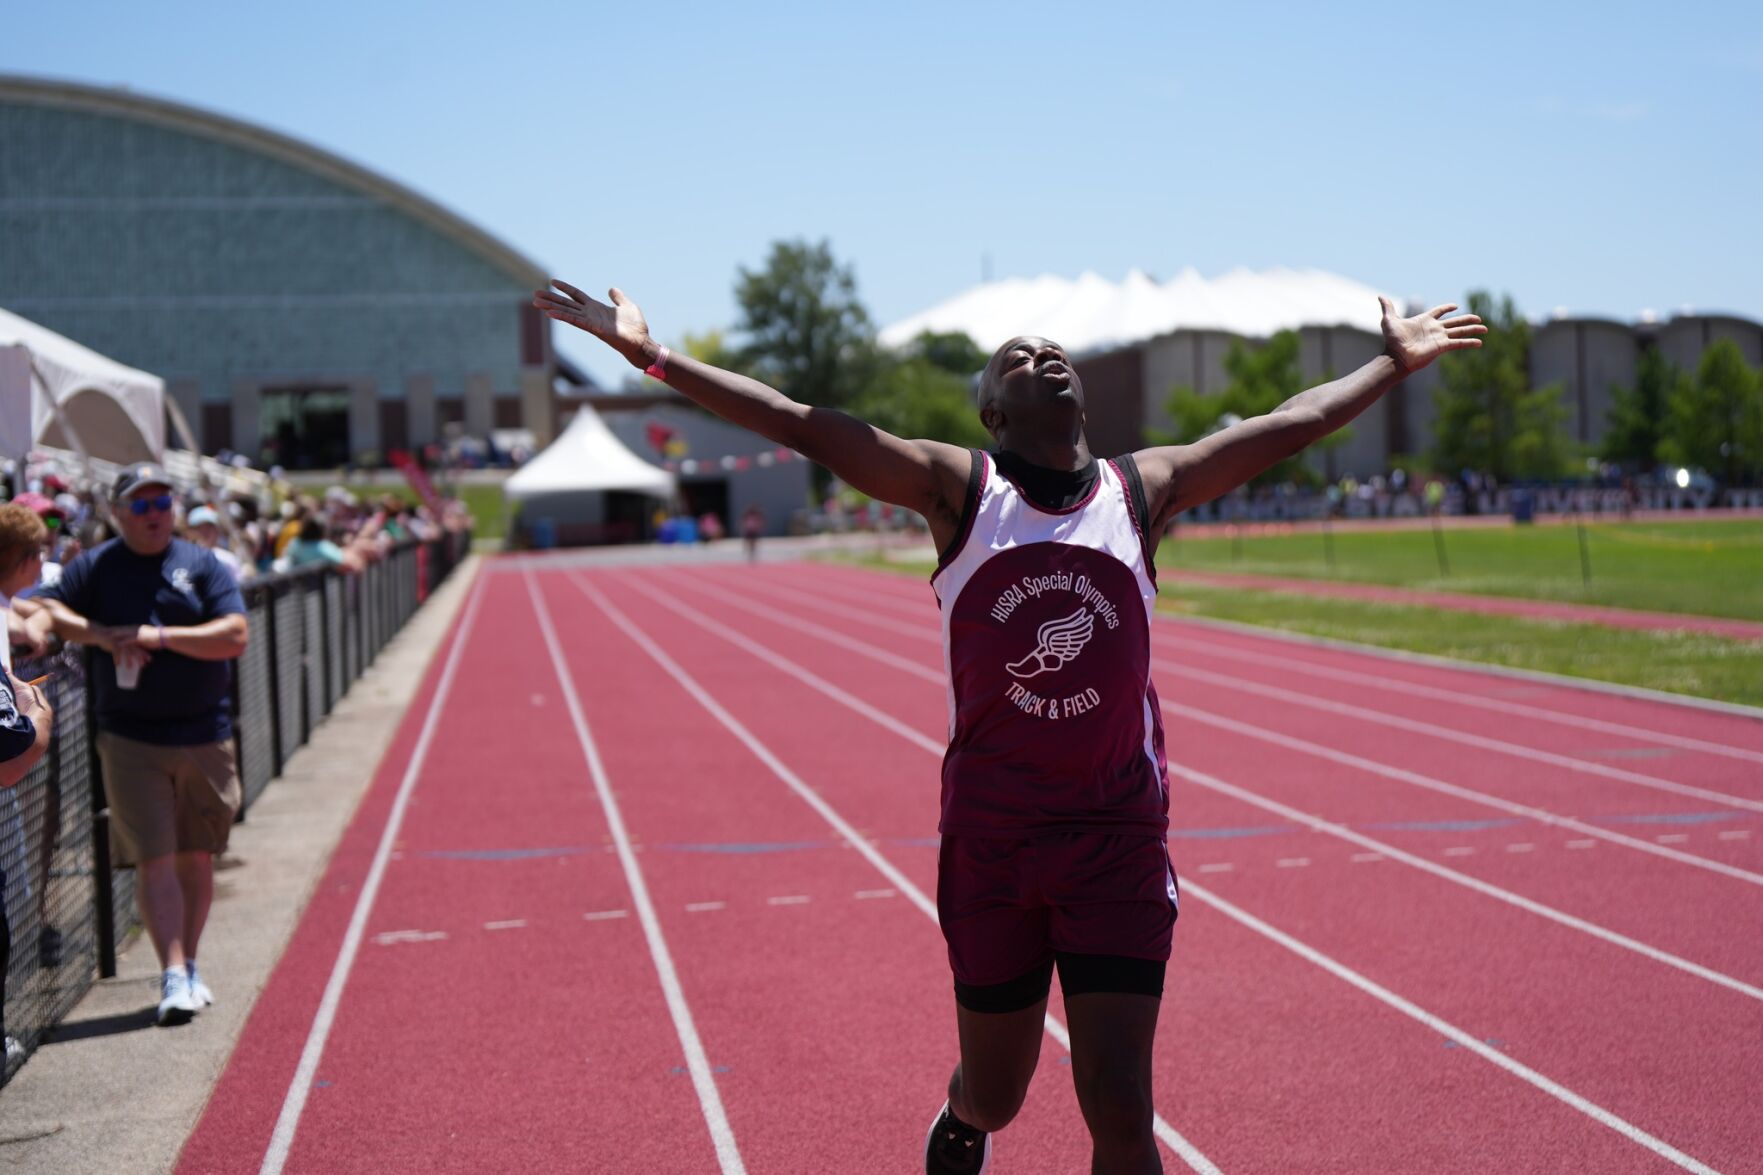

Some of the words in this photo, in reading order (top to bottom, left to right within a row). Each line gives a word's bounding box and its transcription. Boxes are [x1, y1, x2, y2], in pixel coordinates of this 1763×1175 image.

[990, 583, 1028, 624] HISRA
[1022, 571, 1073, 598] Special
[1075, 575, 1120, 630] Olympics
[1005, 681, 1046, 718] TRACK
[1048, 699, 1059, 720] &
[1063, 687, 1101, 718] FIELD
